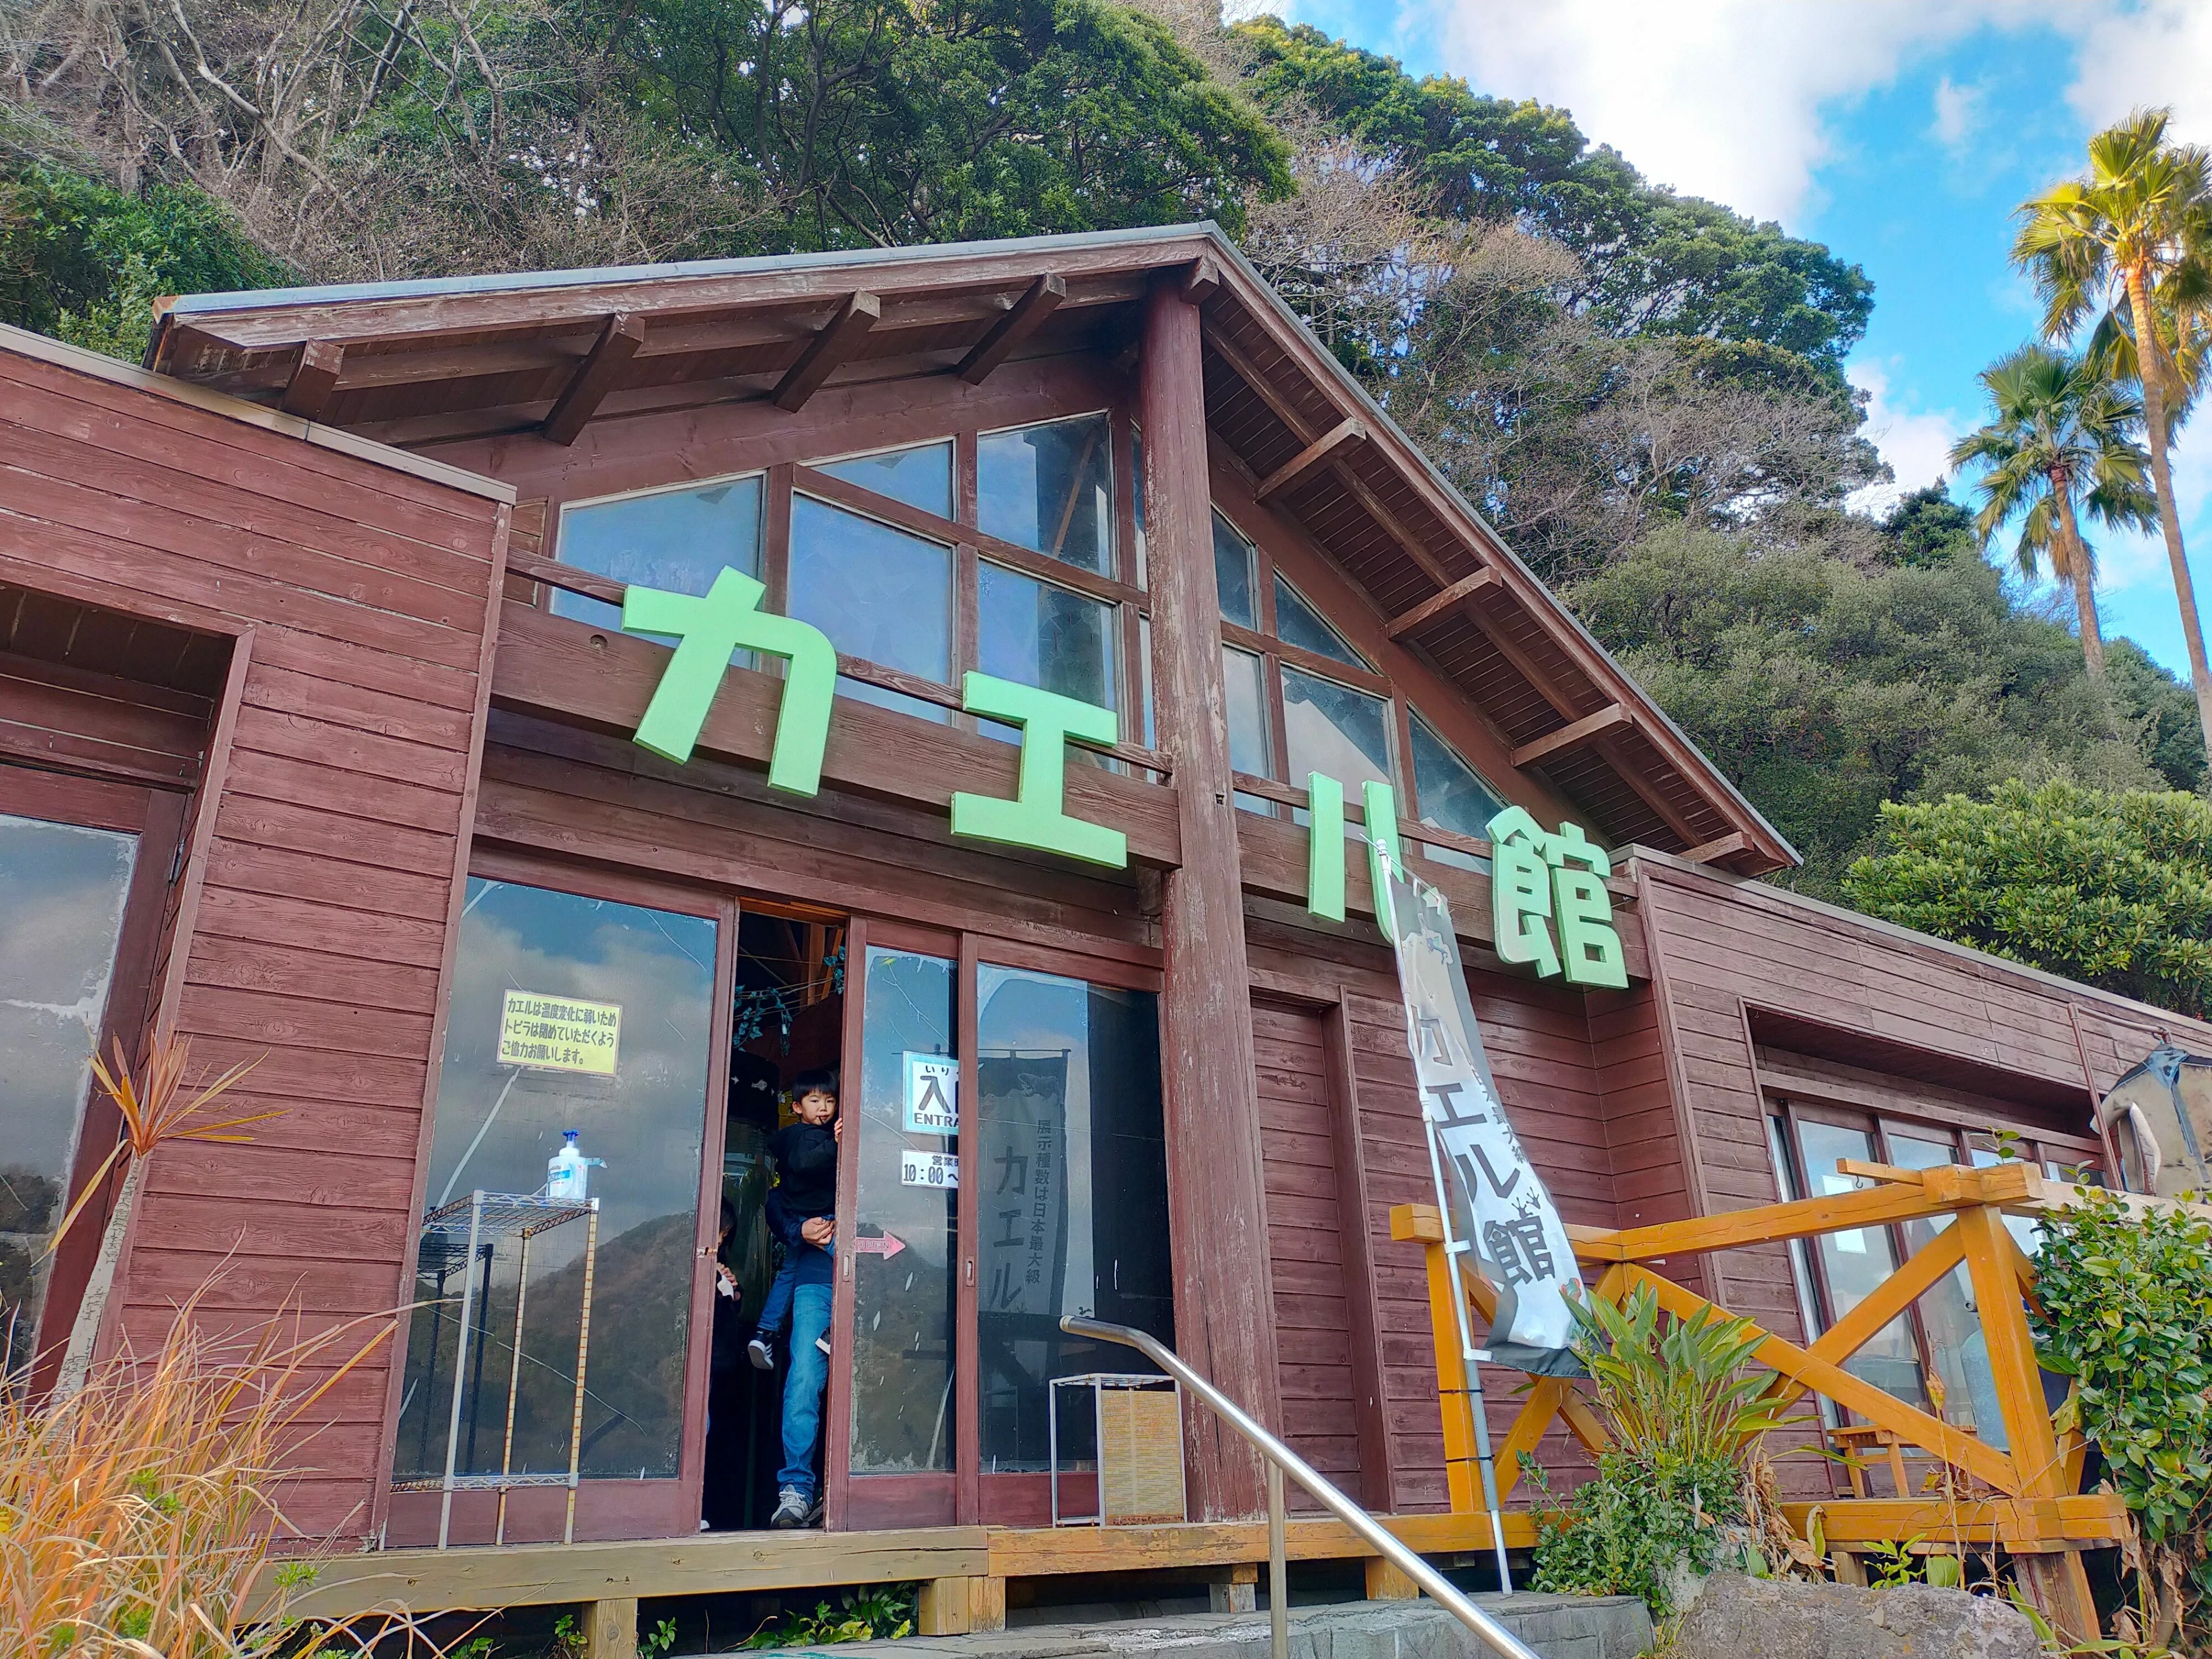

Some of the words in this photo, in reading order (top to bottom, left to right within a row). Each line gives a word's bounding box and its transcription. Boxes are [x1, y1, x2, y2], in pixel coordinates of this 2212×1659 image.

[622, 565, 1629, 989] カエル館
[508, 998, 616, 1027] カエルは温度変化に弱いため
[505, 1019, 615, 1048] トビラは閉めていただくよう
[502, 1040, 584, 1065] ご協力お願いします。
[919, 1075, 959, 1114] 入
[1411, 1005, 1555, 1285] カエル館
[1026, 1119, 1052, 1284] 展示種数は日本最大級
[858, 1240, 891, 1250] OPEN
